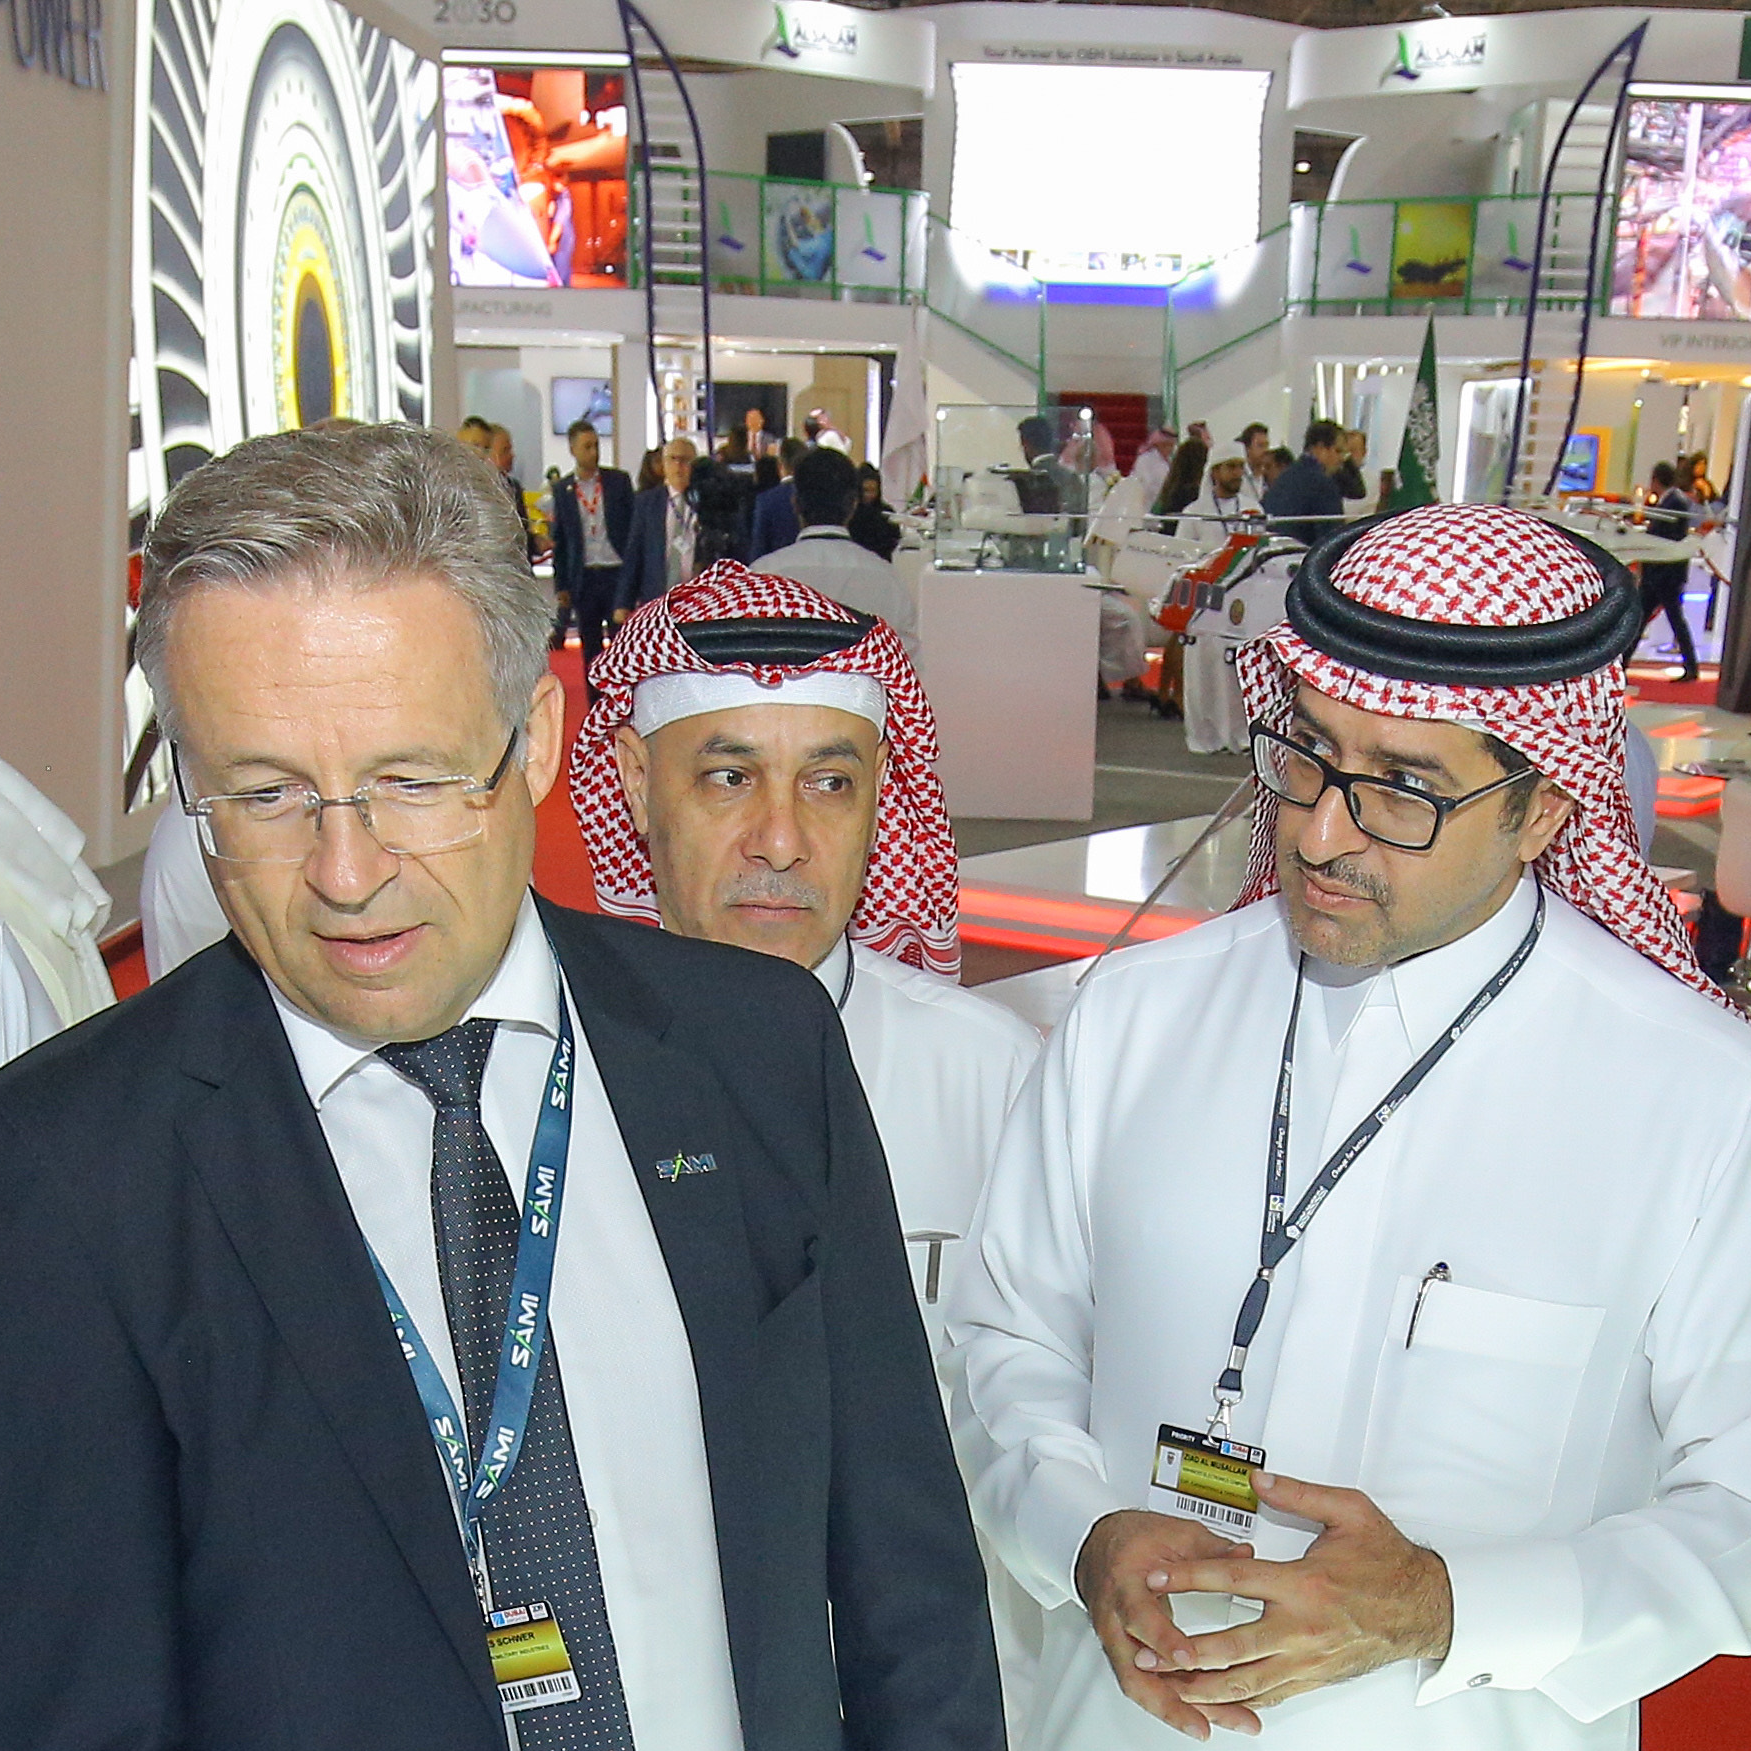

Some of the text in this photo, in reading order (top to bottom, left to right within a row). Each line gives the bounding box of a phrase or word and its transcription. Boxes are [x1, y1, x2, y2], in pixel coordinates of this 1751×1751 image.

[530, 1165, 557, 1238] SAMI
[510, 1292, 540, 1369] SAMI
[433, 1415, 469, 1492] SAMI
[475, 1425, 516, 1500] SAMI
[496, 1631, 536, 1647] SCHWER
